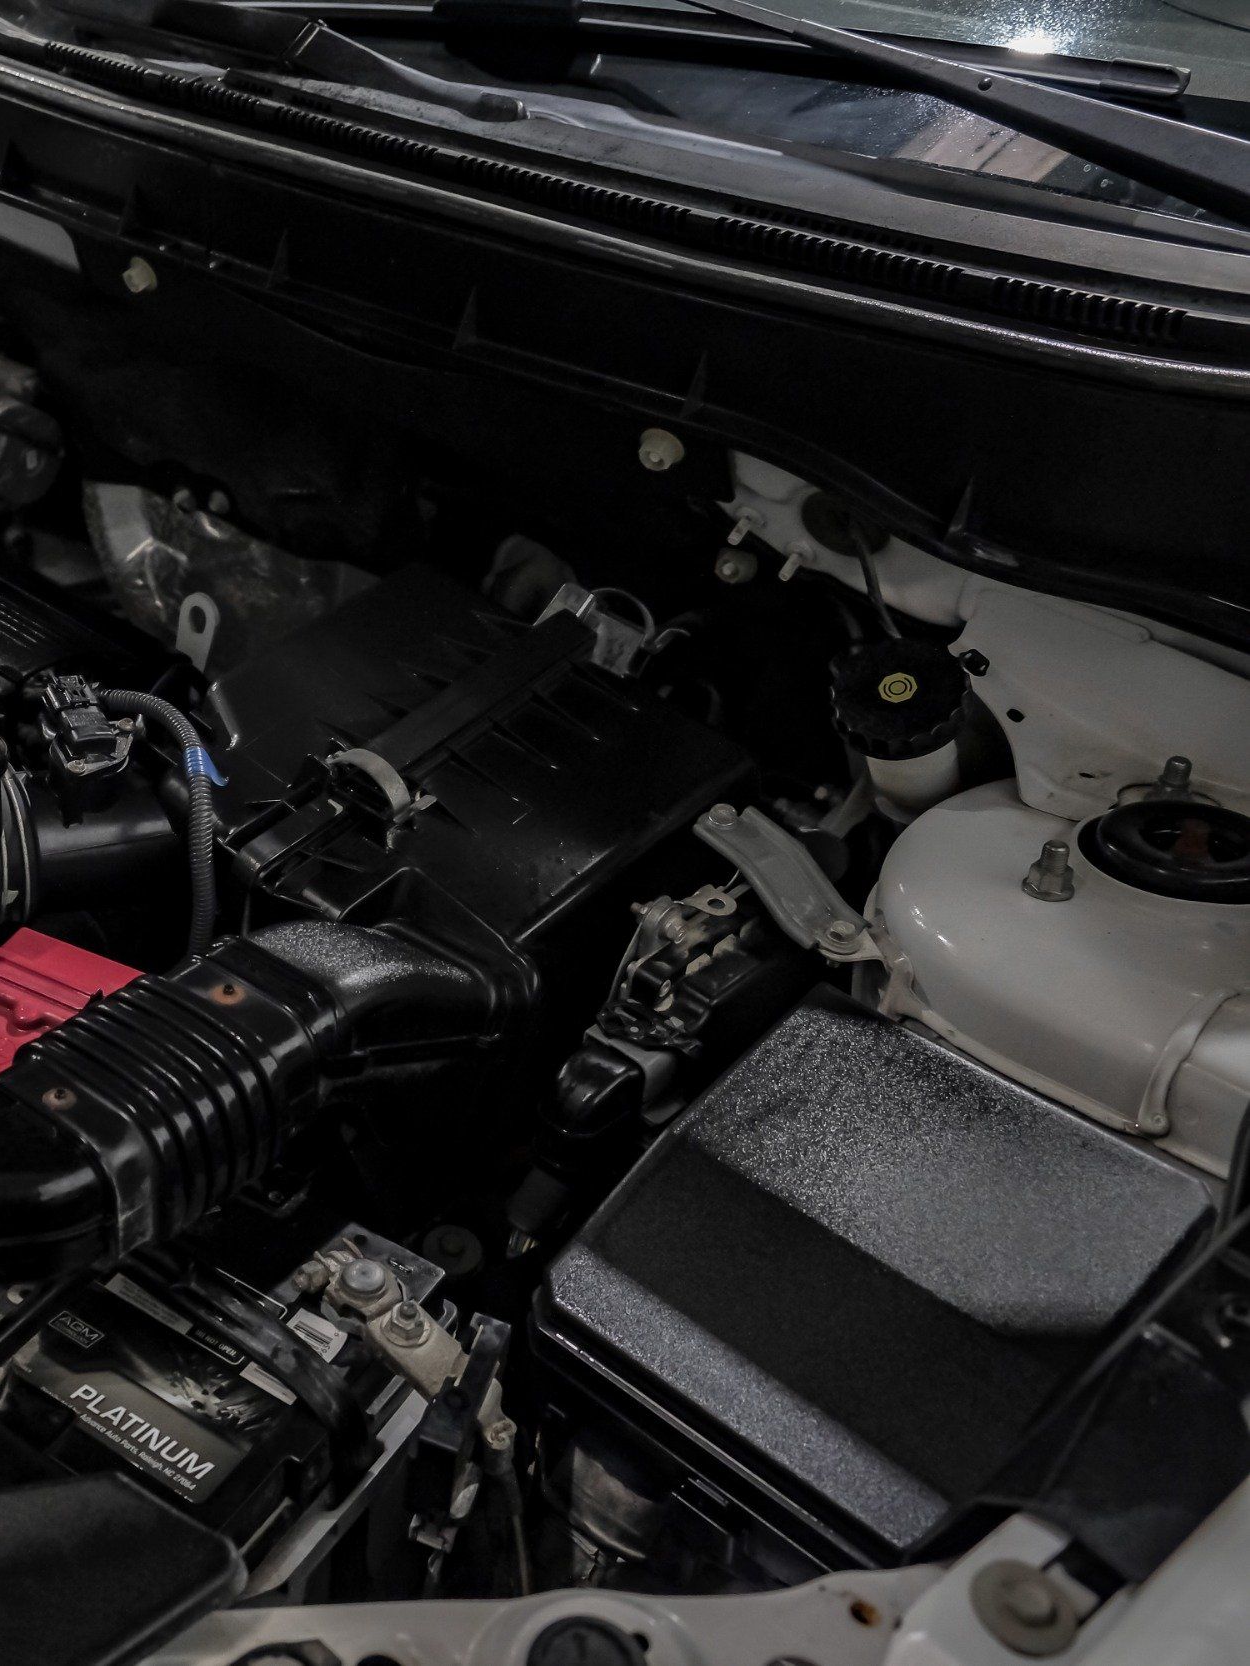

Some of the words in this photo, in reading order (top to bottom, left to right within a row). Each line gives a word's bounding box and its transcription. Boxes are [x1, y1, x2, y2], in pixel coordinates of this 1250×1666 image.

[218, 1343, 237, 1357] OPEN
[69, 1384, 216, 1481] PLATINUM
[79, 1413, 106, 1433] Advance
[105, 1430, 122, 1443] Auto
